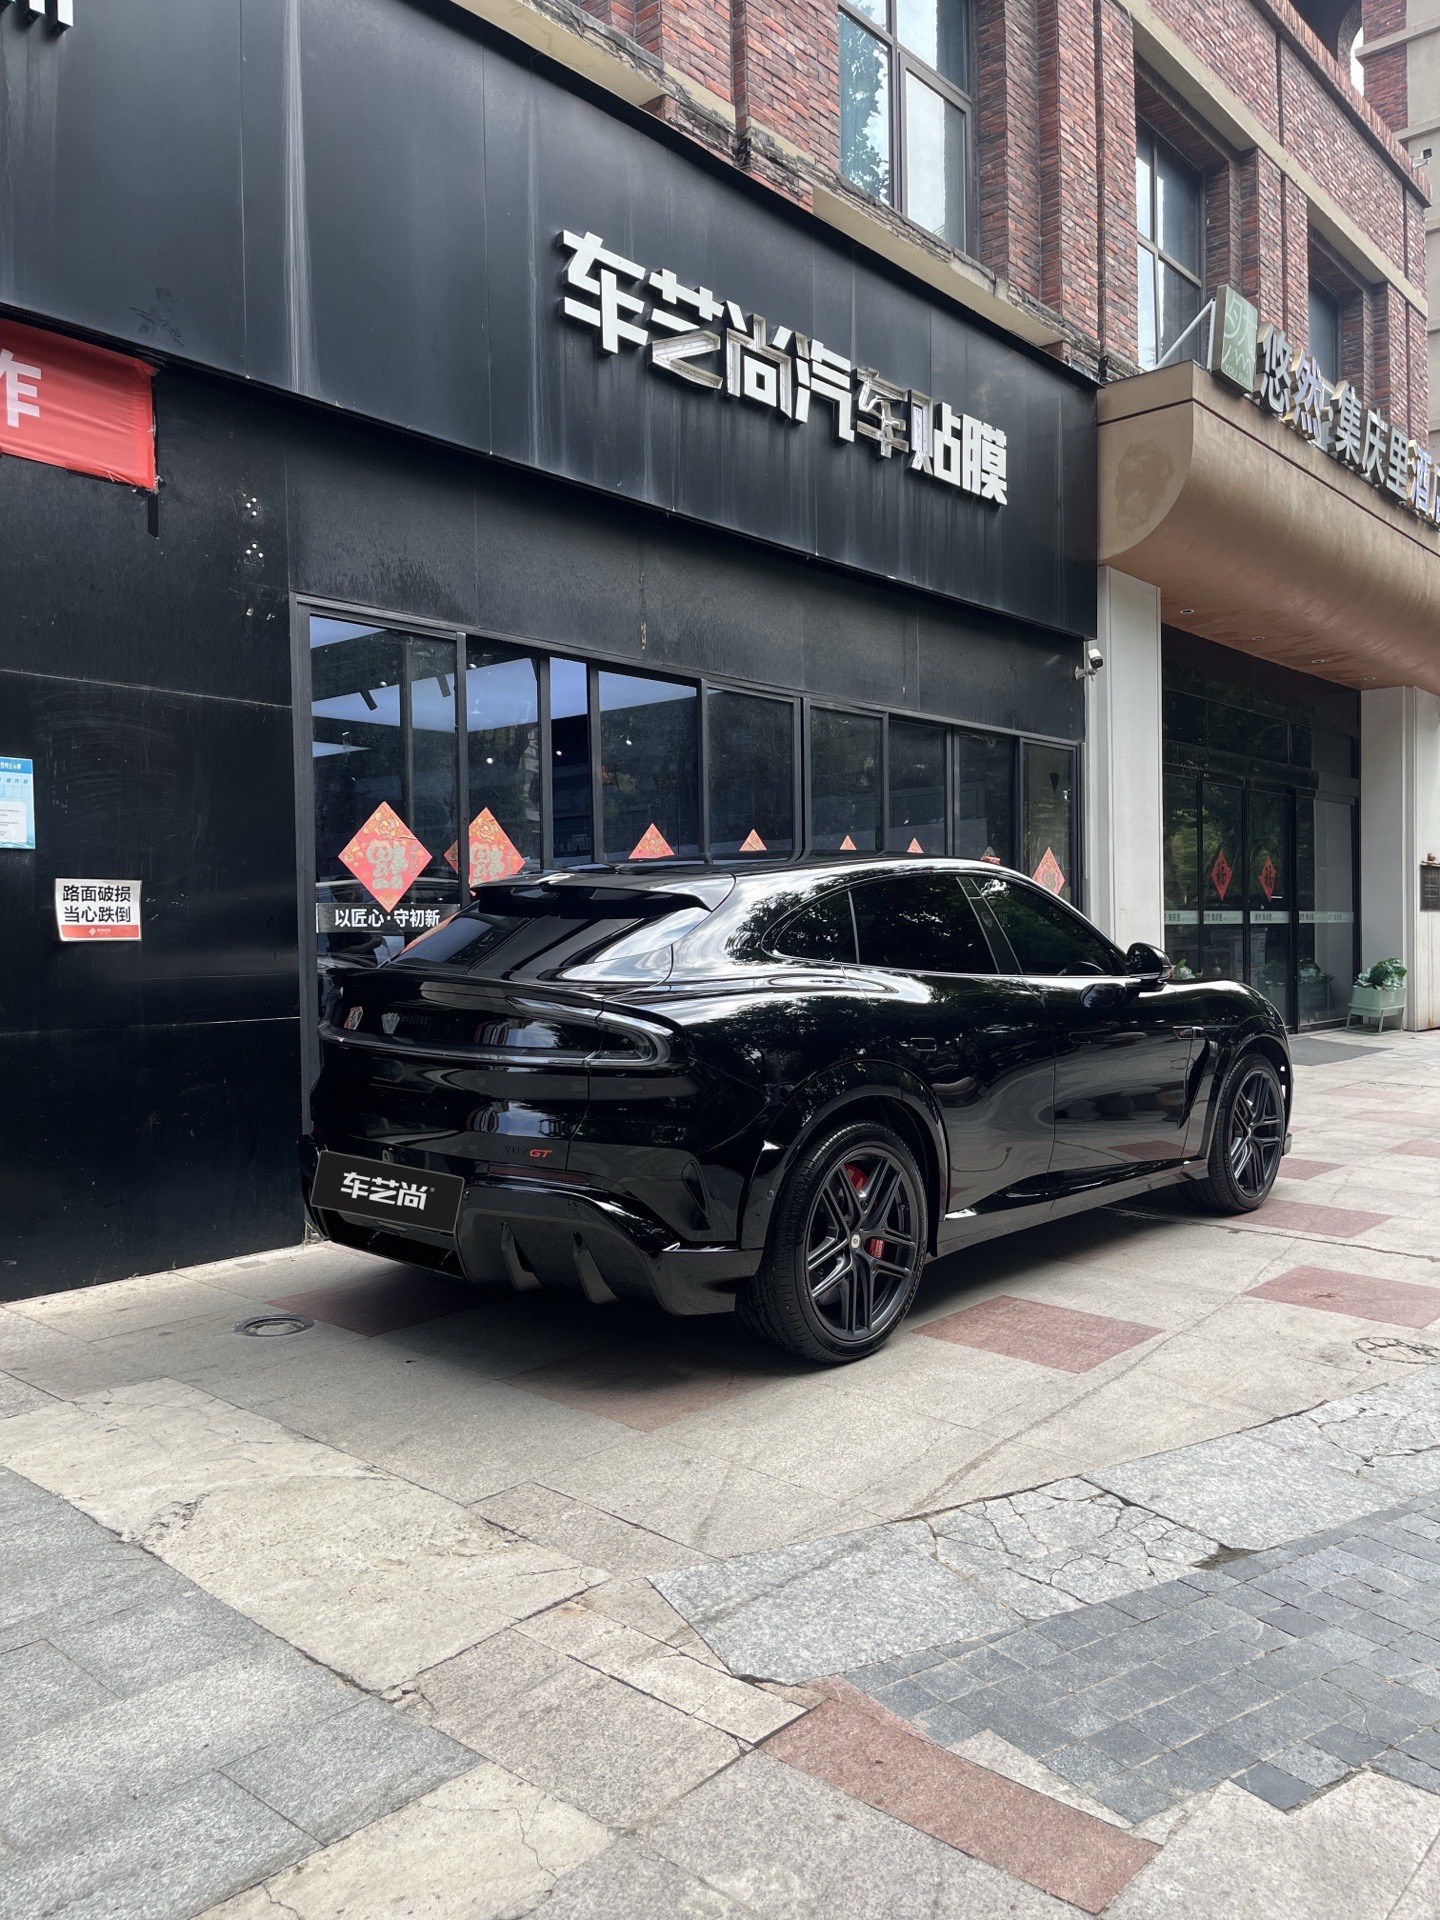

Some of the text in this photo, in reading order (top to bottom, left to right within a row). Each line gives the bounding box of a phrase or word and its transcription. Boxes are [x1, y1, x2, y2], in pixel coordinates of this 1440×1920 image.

[558, 229, 1008, 505] 车艺尚汽车贴膜
[62, 885, 131, 902] 路面破损
[64, 906, 131, 923] 当心跌倒
[334, 908, 441, 928] 以匠心·守初新
[529, 1149, 552, 1158] GT
[340, 1171, 428, 1211] 车艺尚
